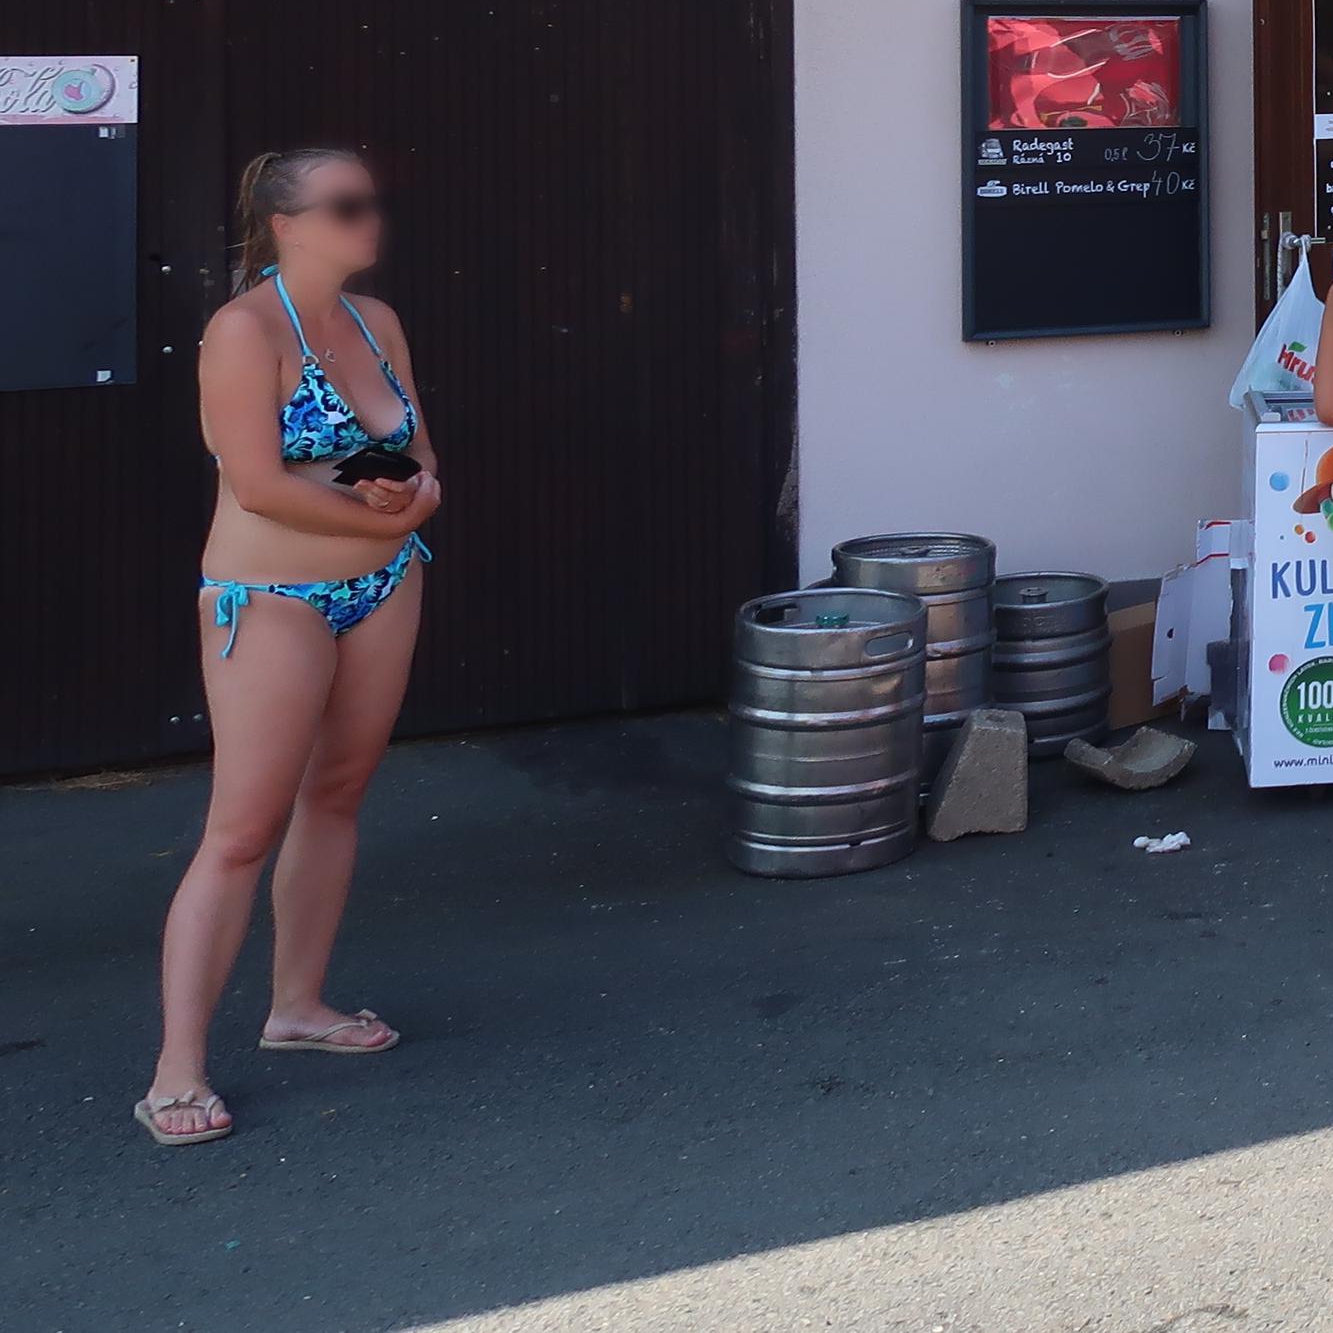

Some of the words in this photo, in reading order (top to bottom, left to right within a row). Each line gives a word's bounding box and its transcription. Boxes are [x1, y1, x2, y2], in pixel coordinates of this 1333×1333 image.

[1012, 138, 1074, 154] Radegast
[1182, 142, 1196, 154] Kč
[1056, 153, 1072, 163] 10
[1012, 181, 1050, 195] Birell
[1055, 179, 1104, 194] Pomelo
[1106, 180, 1115, 192] &
[1117, 179, 1150, 198] Grep
[1181, 178, 1196, 190] Kč
